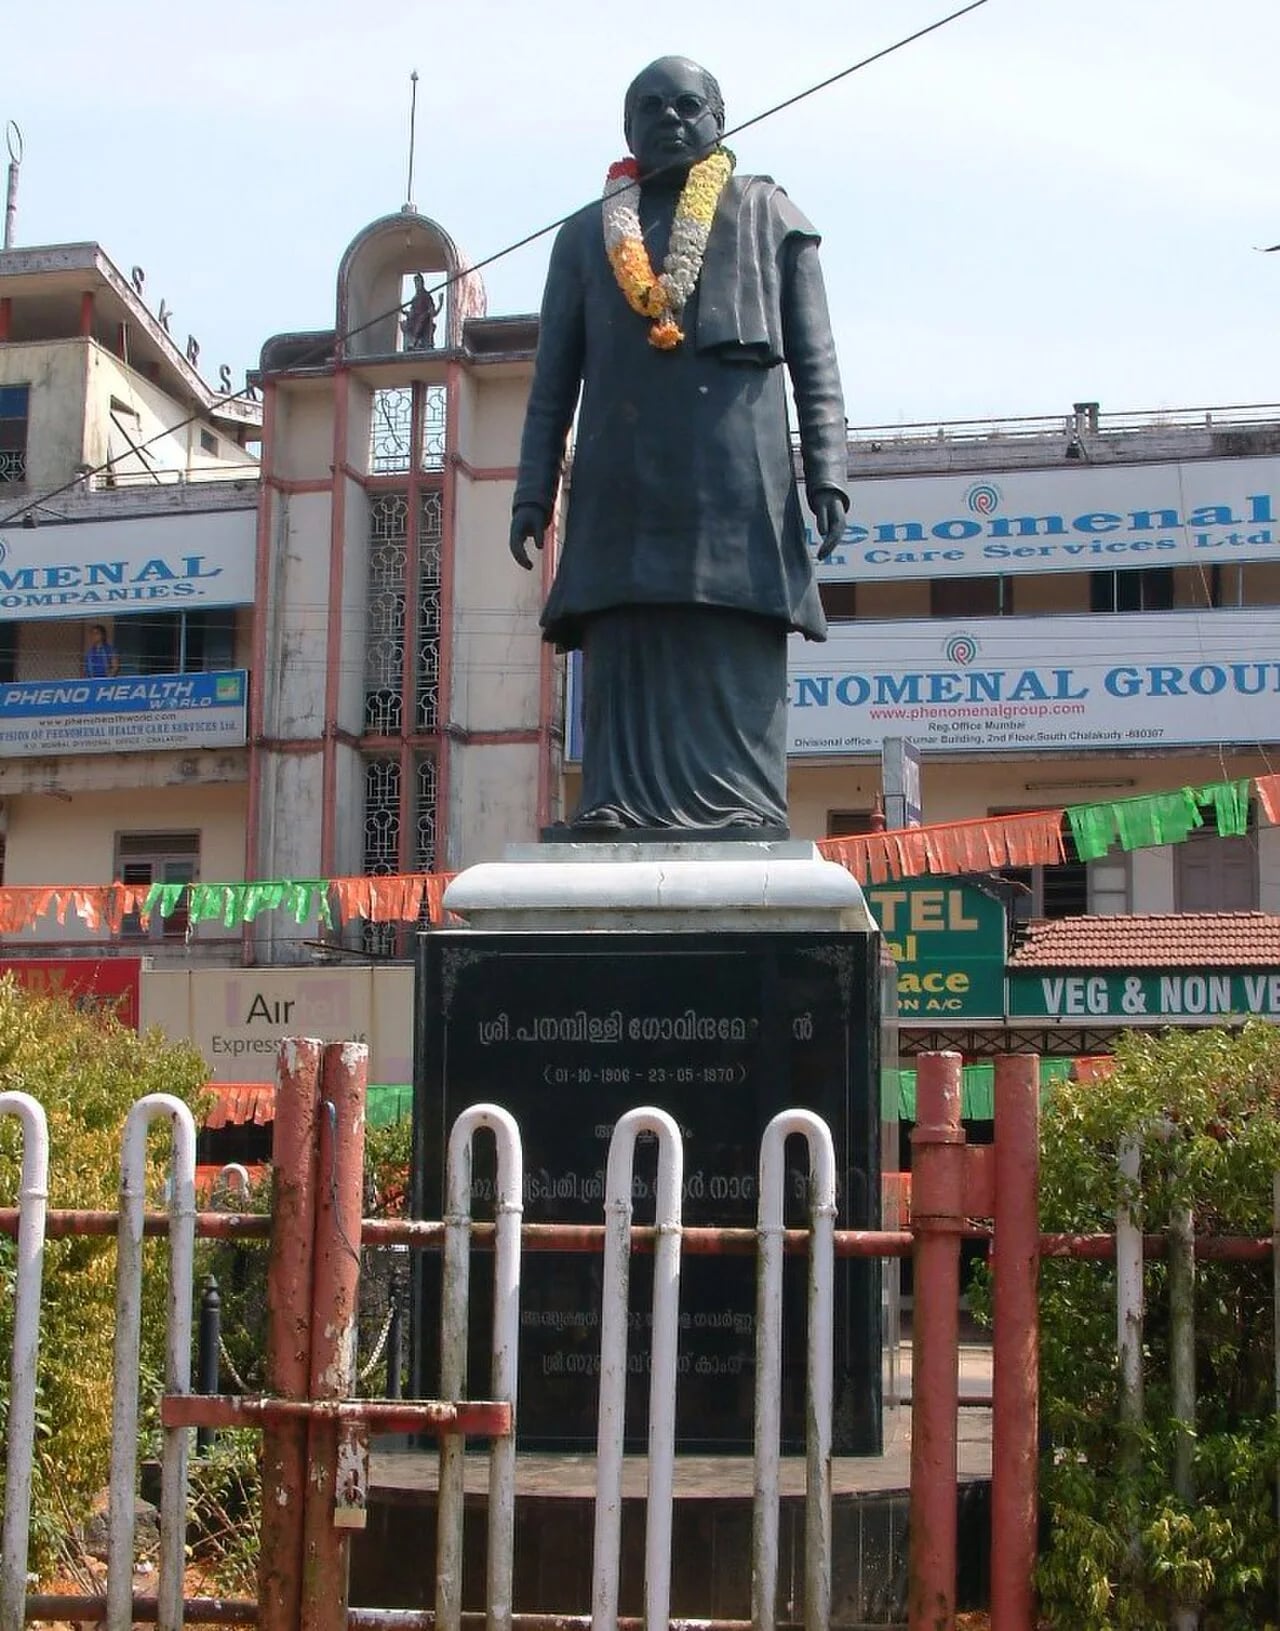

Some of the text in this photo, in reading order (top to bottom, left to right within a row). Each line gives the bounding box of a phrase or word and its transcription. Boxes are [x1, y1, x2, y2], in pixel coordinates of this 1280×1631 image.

[864, 550, 965, 563] Care
[983, 539, 1176, 558] Services
[5, 681, 194, 706] PHENO HEALTH
[788, 669, 1088, 707] NOMENAL
[870, 703, 1085, 721] www.phenomenalgroup.com
[926, 998, 964, 1011] A/C
[1041, 977, 1109, 1014] VEG
[1122, 975, 1148, 1014] &
[1160, 976, 1232, 1014] NON
